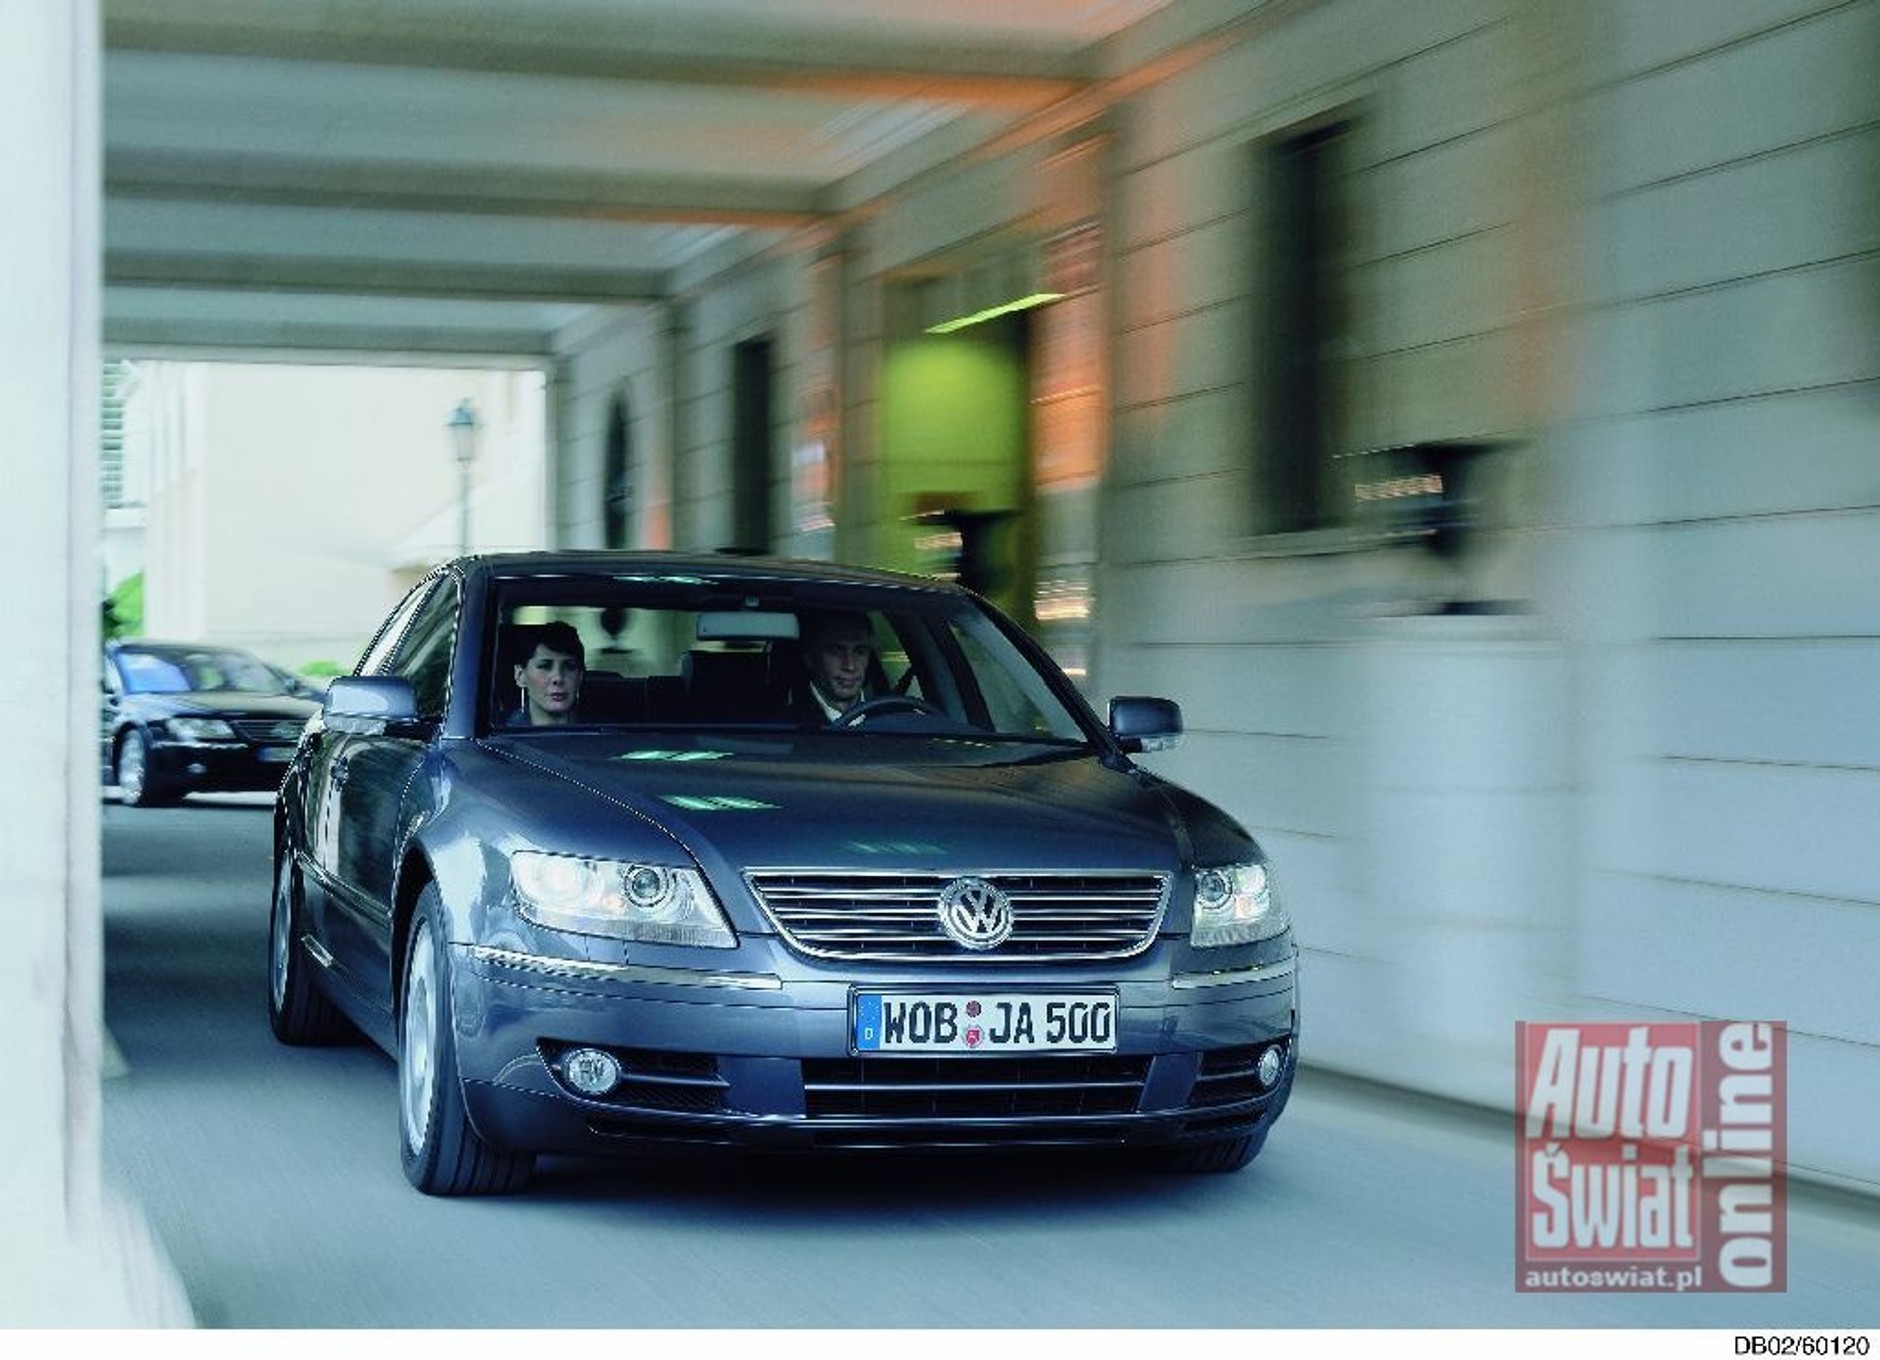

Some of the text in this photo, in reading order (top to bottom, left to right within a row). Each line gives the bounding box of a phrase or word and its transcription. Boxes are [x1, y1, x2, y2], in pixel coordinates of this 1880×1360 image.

[883, 1001, 958, 1044] WOB
[989, 1002, 1035, 1044] JA
[1046, 1002, 1111, 1043] 500
